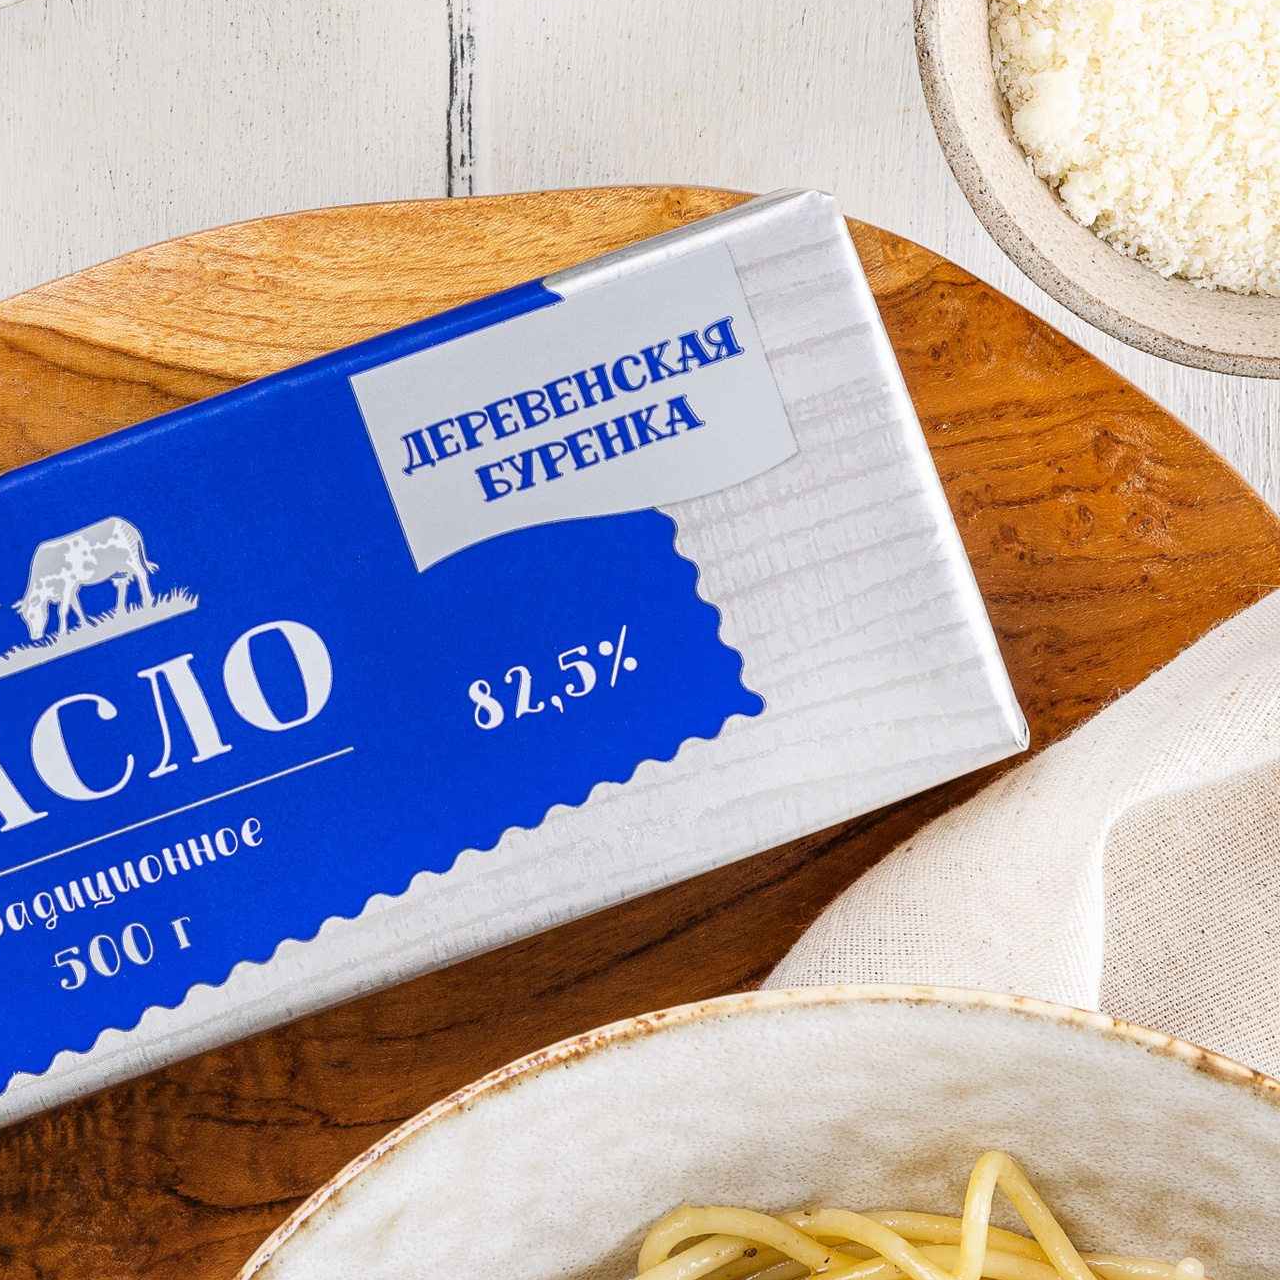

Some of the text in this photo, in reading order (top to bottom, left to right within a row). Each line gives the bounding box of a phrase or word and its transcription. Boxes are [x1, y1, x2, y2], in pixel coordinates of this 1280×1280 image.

[400, 315, 744, 477] ДЕРЕВЕНСКАЯ
[474, 394, 705, 504] БУРЕНКА
[467, 623, 639, 731] 82,5%
[53, 915, 192, 991] 500 г
